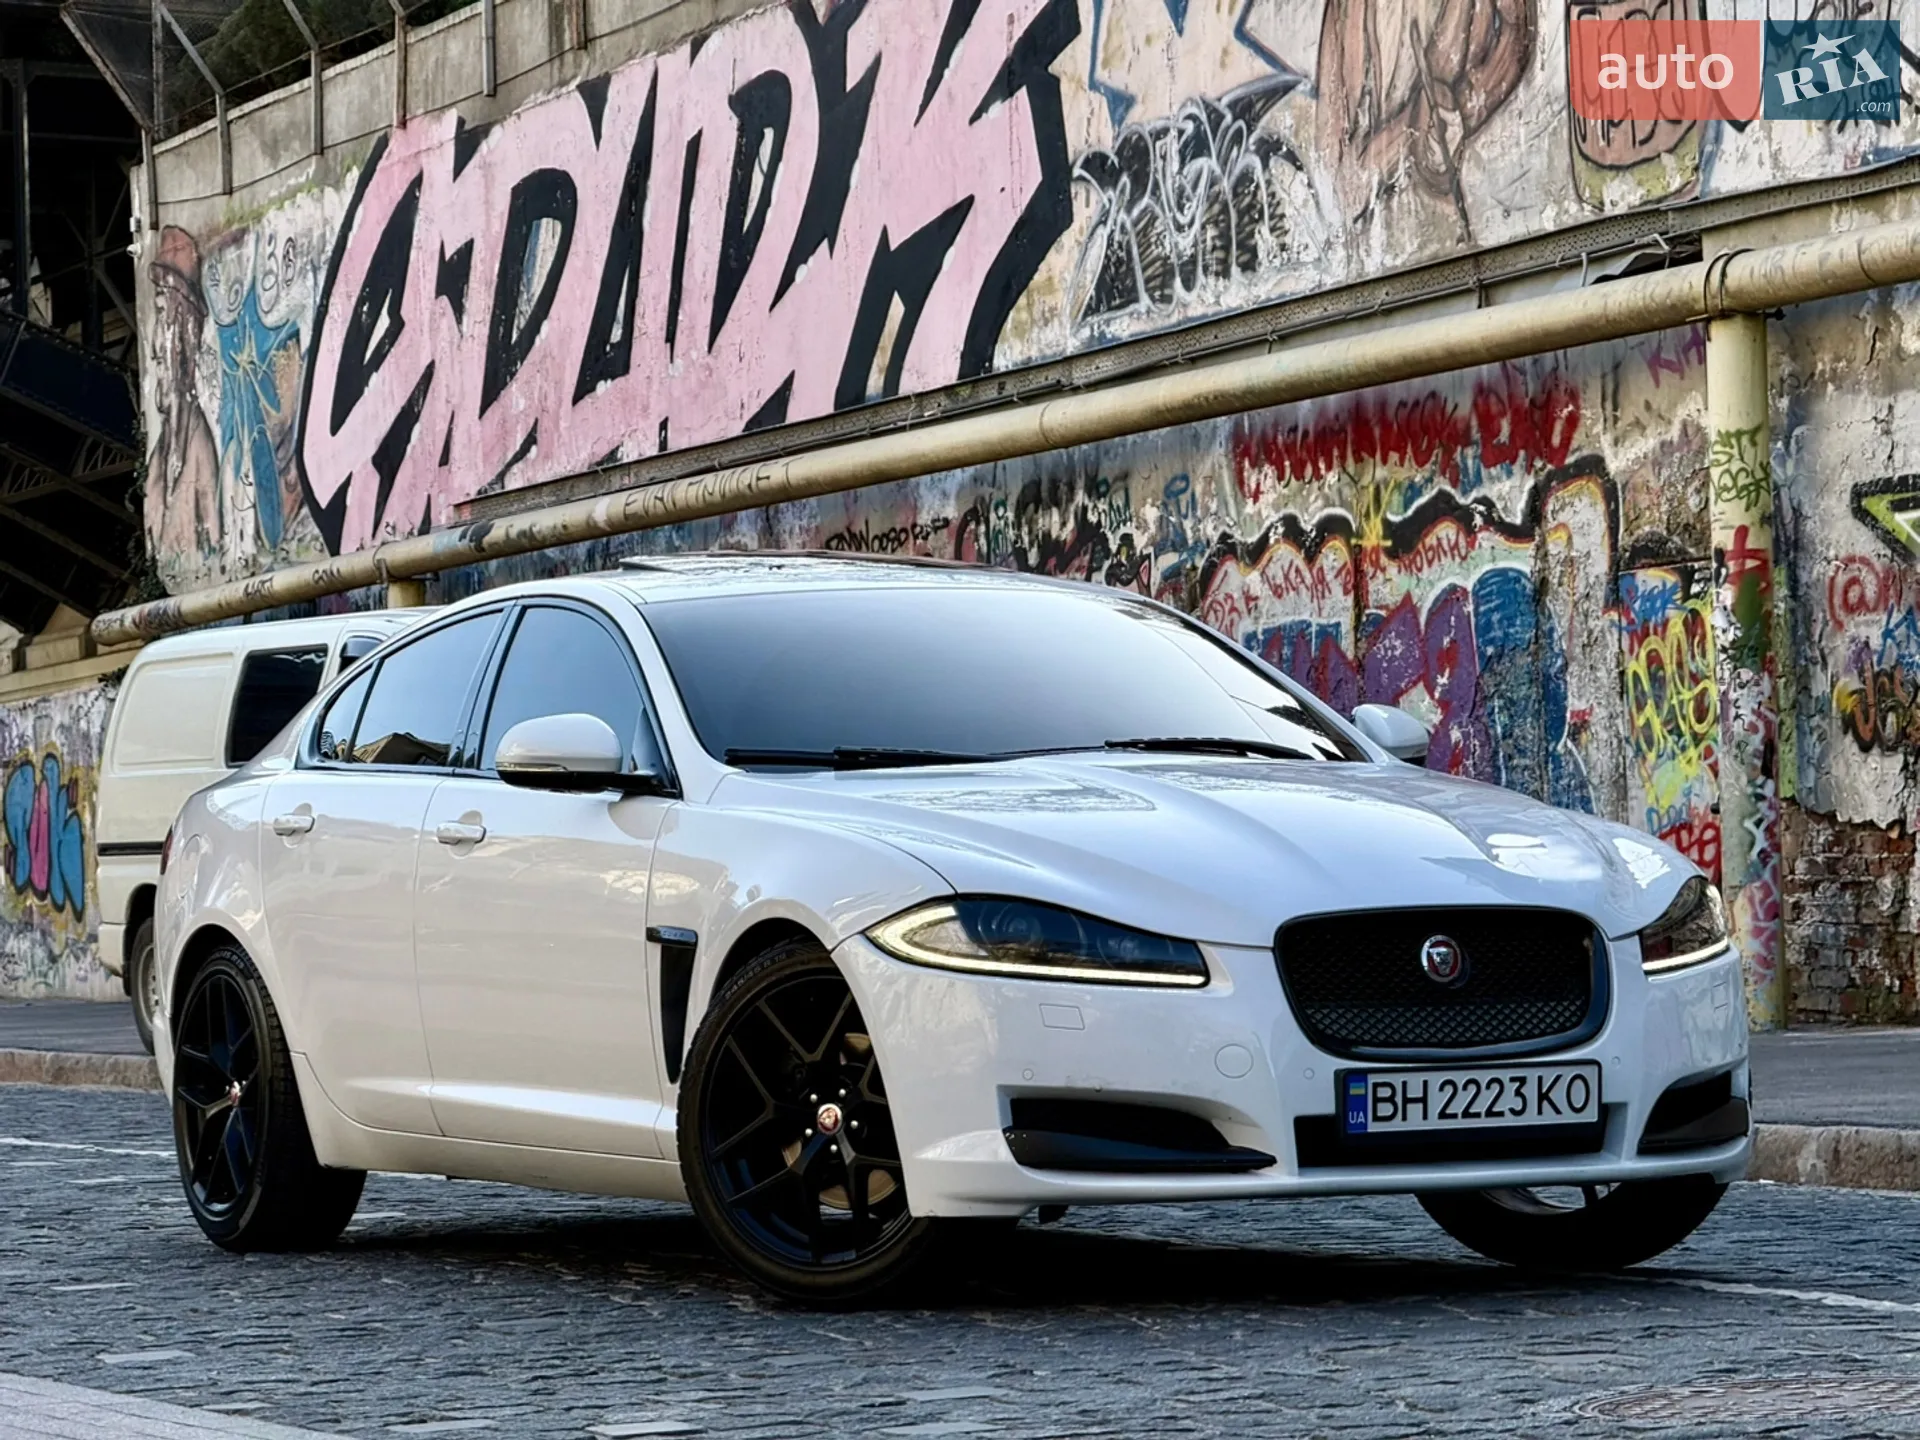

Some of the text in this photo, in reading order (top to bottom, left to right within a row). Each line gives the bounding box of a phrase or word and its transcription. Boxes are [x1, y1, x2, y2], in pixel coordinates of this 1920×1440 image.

[1371, 1073, 1590, 1122] BH 2223 KO
[1349, 1111, 1366, 1124] UA
